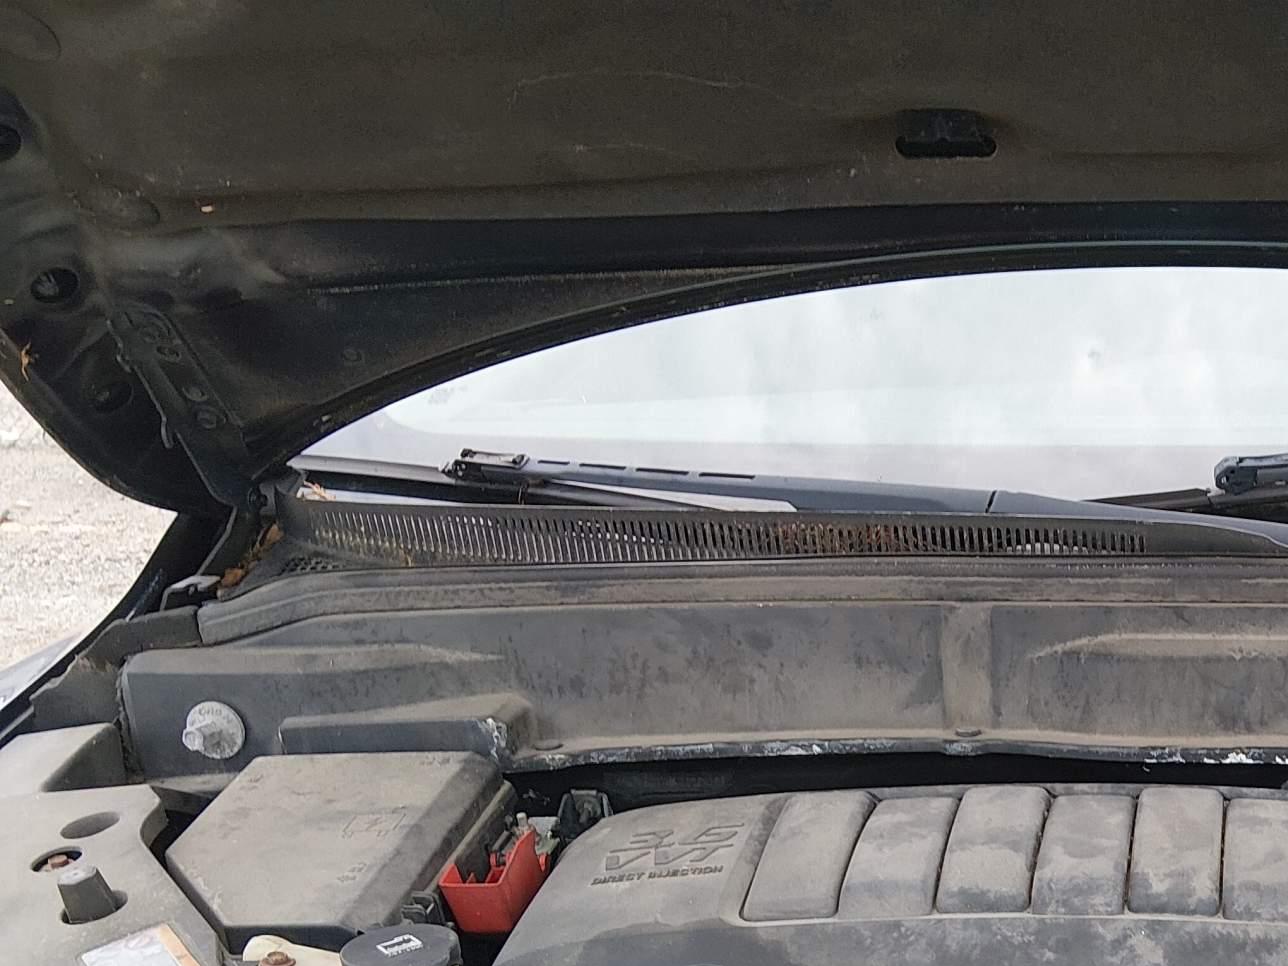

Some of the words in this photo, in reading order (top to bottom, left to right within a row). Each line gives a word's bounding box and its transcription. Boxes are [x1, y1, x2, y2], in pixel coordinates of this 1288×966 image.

[605, 843, 735, 871] VVT
[590, 871, 645, 886] DIRECT
[648, 864, 724, 880] INJECTION
